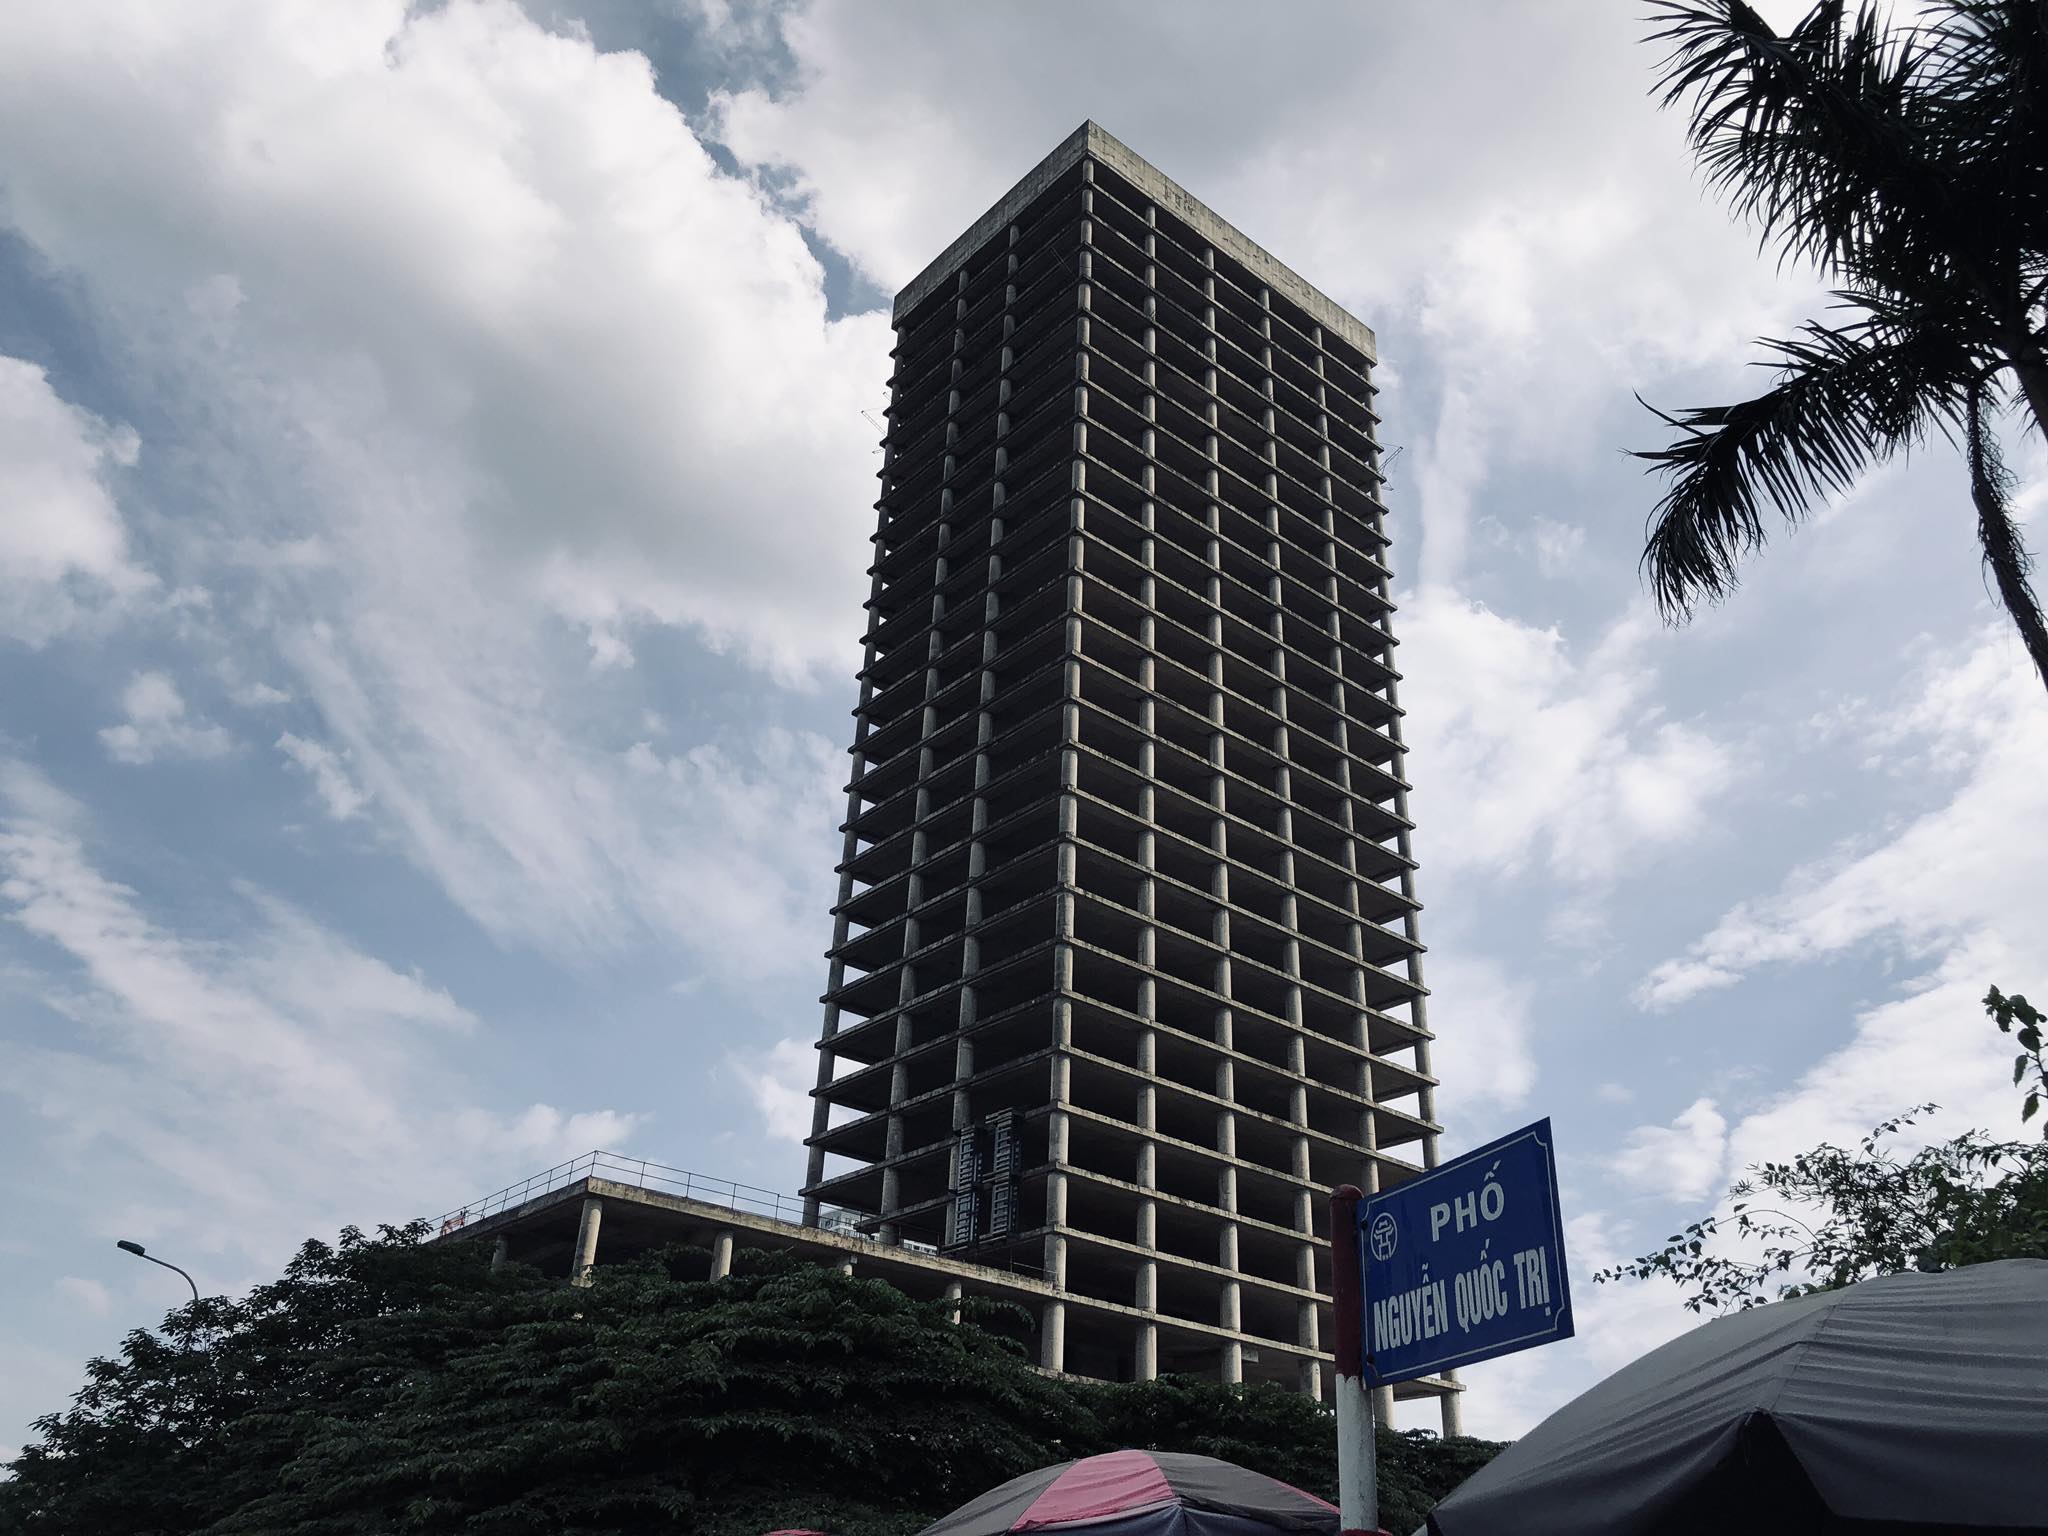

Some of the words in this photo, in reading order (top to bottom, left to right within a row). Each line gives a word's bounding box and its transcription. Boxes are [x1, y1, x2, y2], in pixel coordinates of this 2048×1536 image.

[1430, 1160, 1505, 1242] PHỐ
[1373, 1263, 1449, 1352] NGUYỄN
[1454, 1238, 1509, 1333] QUỐC
[1513, 1246, 1551, 1316] TRỊ
